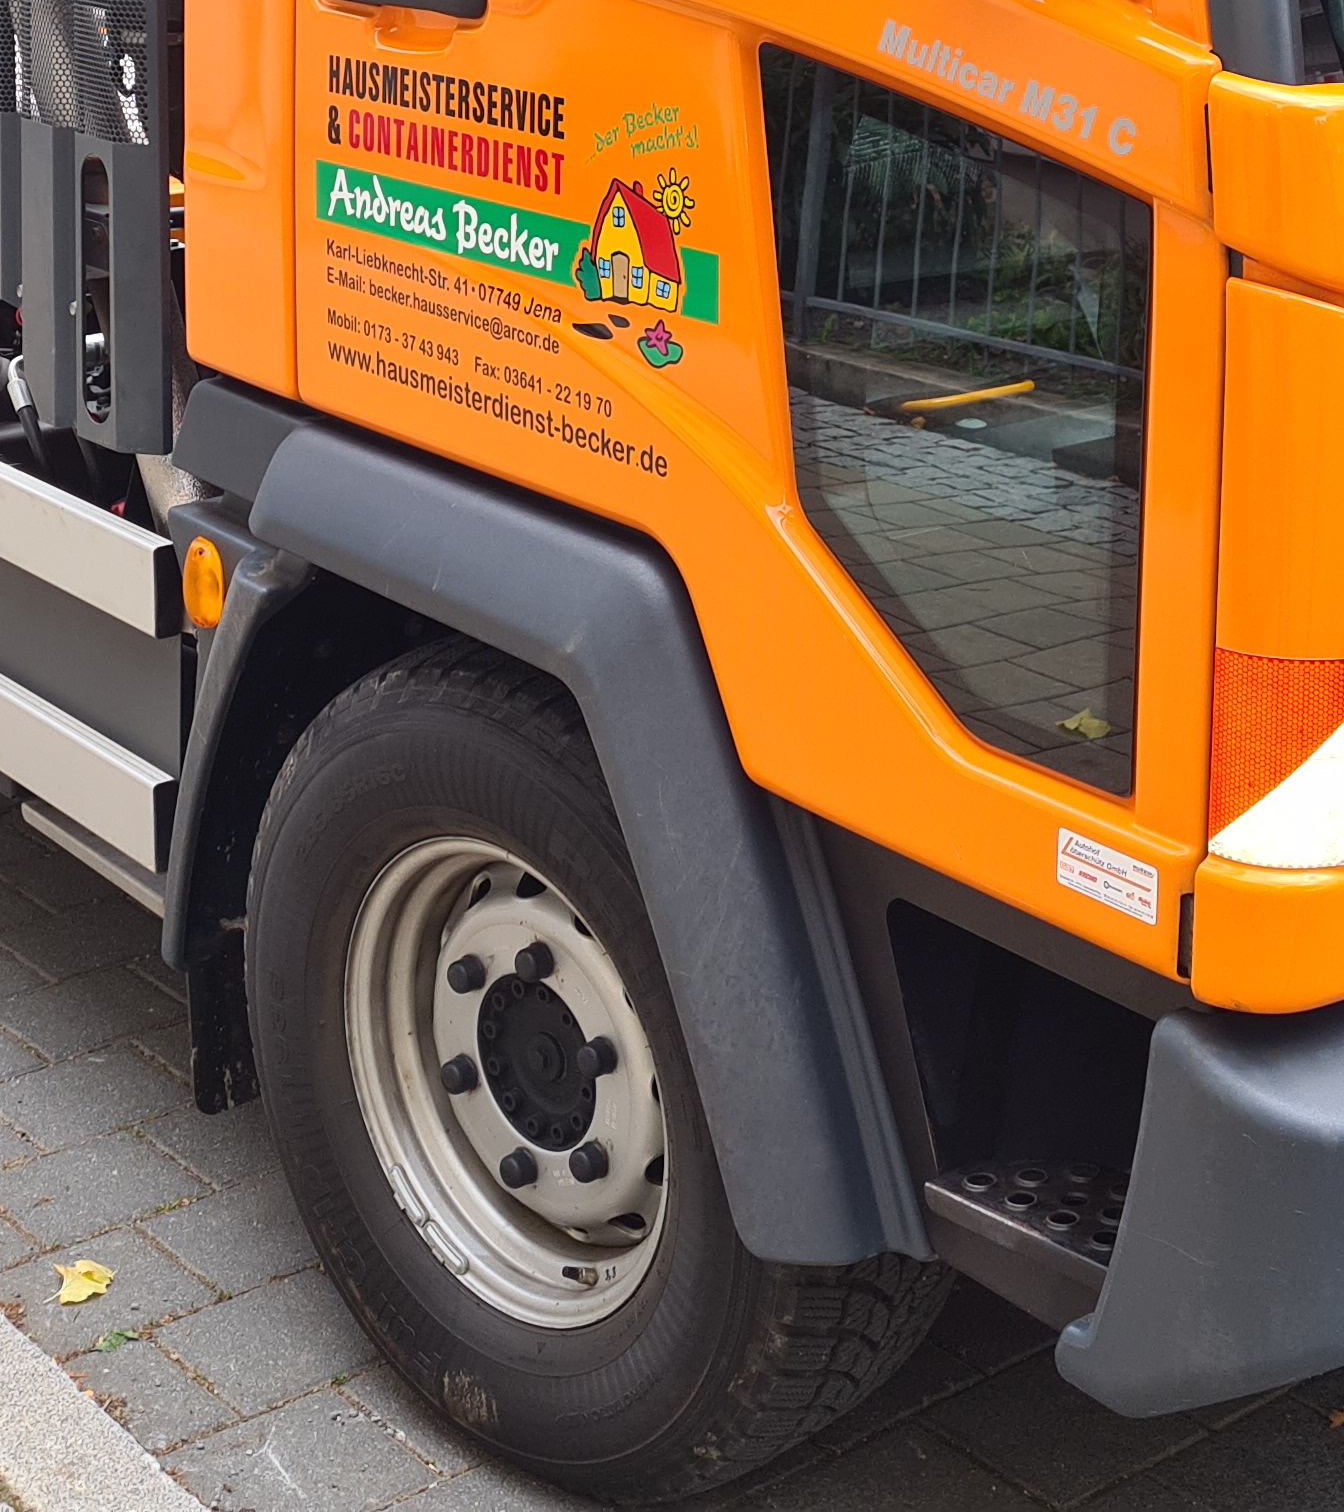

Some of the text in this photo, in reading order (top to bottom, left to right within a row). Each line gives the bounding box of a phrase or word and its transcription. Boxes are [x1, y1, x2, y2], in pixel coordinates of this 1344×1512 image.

[328, 54, 565, 140] HAUSMEISTERSERVICE
[622, 102, 679, 138] Becker
[877, 19, 1137, 156] Multicar M31 C
[327, 104, 565, 196] & CONTAINERDIENST
[630, 124, 700, 159] macht's!
[327, 168, 559, 272] Andreas Becker
[326, 238, 451, 291] Karl-Liebknecht-Str.
[523, 296, 563, 324] Jena
[326, 266, 560, 355] E-Mail: becker.hausservice@arcor.de
[327, 307, 361, 334] Mobil:
[363, 319, 392, 344] 0173
[401, 333, 417, 351] 37
[418, 338, 434, 358] 43
[436, 344, 460, 366] 943
[474, 355, 501, 381] Fax:
[503, 365, 543, 395] 03641
[555, 383, 572, 405] 22
[575, 390, 592, 410] 19
[596, 396, 613, 418] 70
[327, 340, 669, 478] www.hausmeisterdienst-becker.de
[1106, 862, 1128, 878] GmbH
